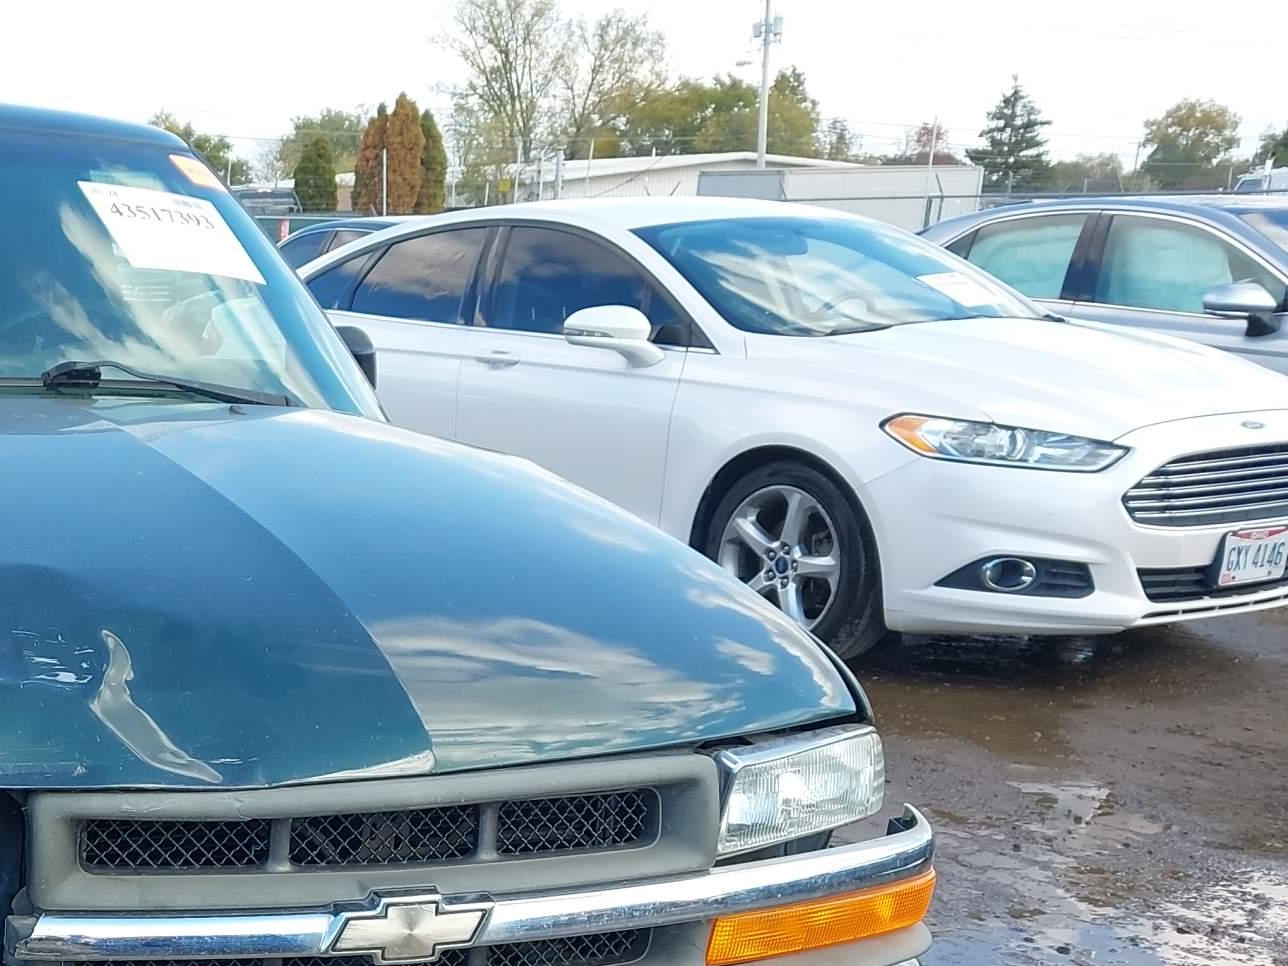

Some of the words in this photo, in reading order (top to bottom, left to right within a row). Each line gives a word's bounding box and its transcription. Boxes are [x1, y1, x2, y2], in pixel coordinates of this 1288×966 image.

[110, 202, 215, 230] 43517393
[1226, 545, 1251, 572] GXY
[1252, 541, 1286, 568] 4146
